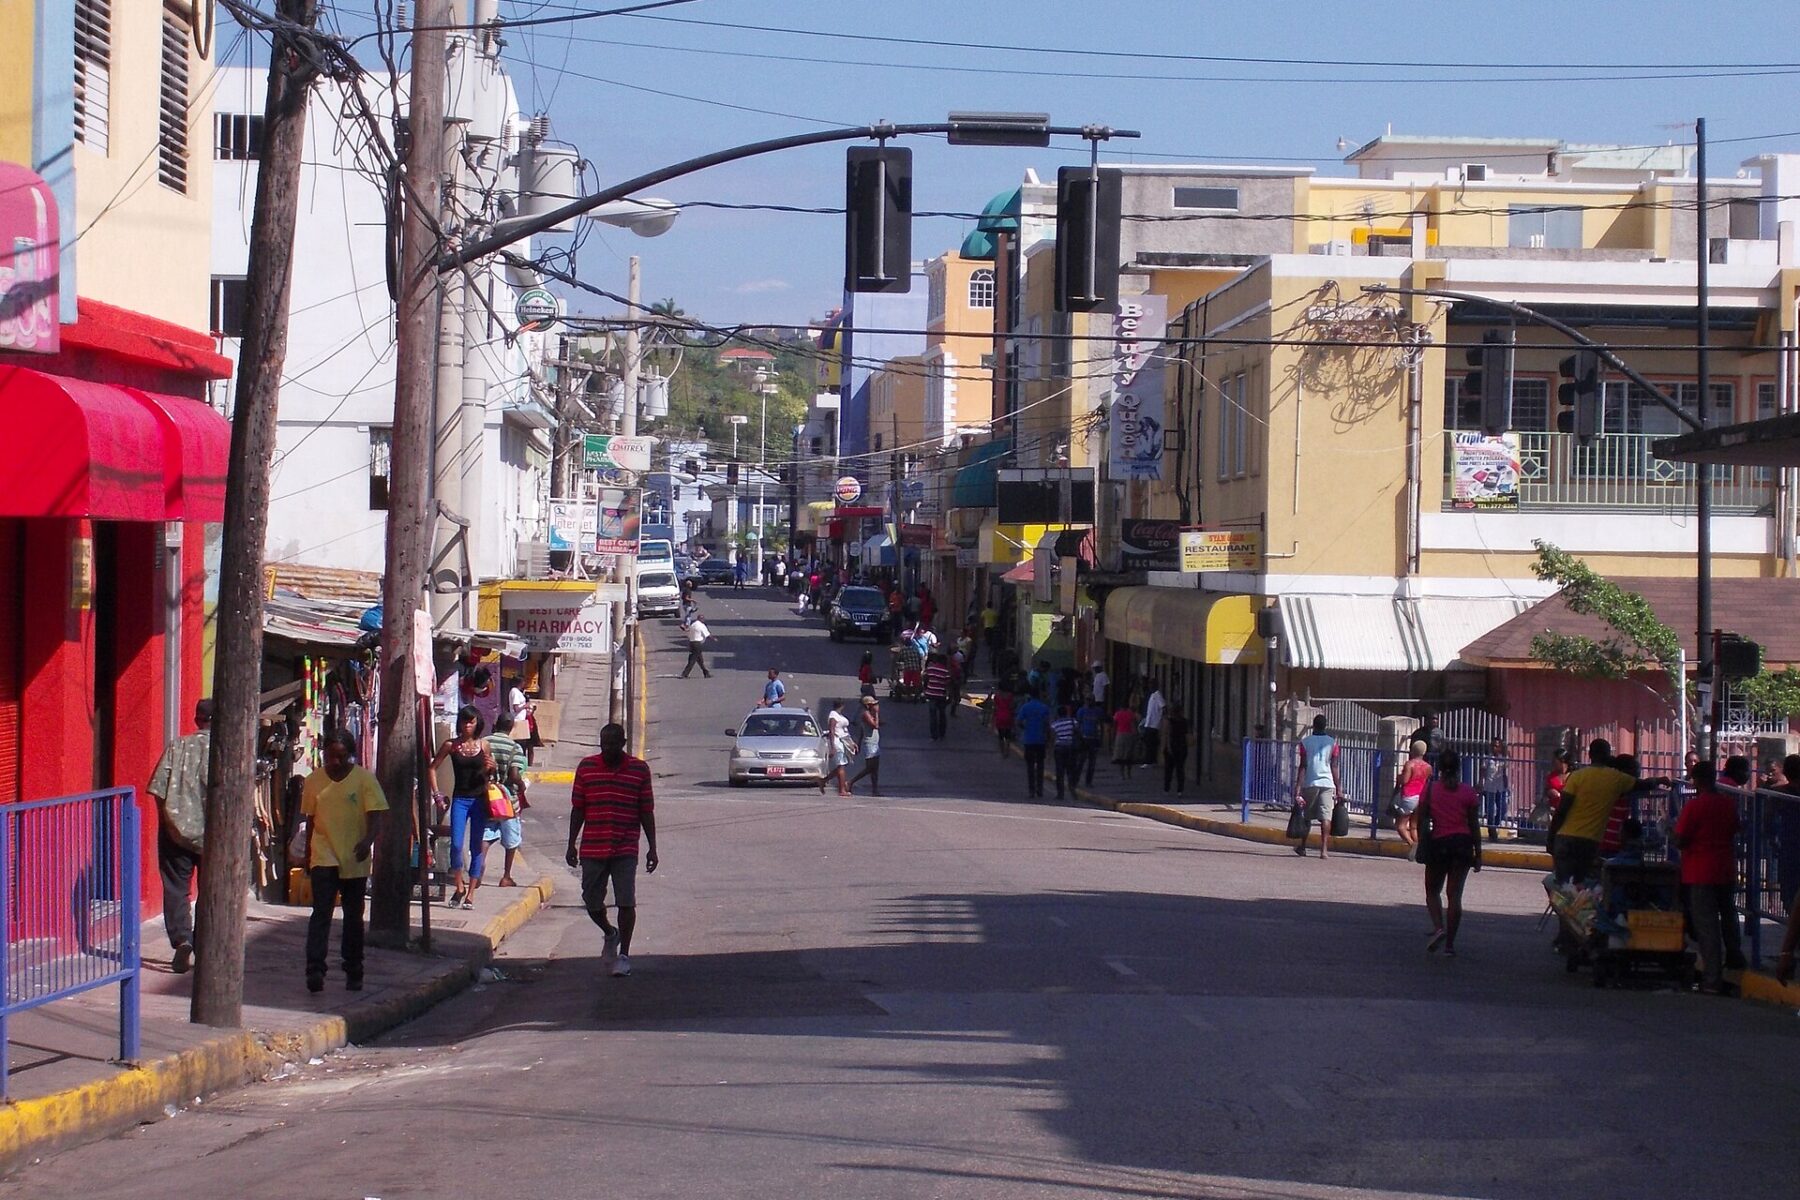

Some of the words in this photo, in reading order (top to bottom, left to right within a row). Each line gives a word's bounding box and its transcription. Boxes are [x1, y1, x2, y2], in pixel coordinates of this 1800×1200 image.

[520, 306, 555, 314] Heineken
[1118, 303, 1143, 385] Beauty
[554, 516, 593, 530] Interet
[1185, 544, 1256, 553] RESTAURANT
[556, 608, 581, 616] CARE
[516, 620, 603, 634] PHARMACY
